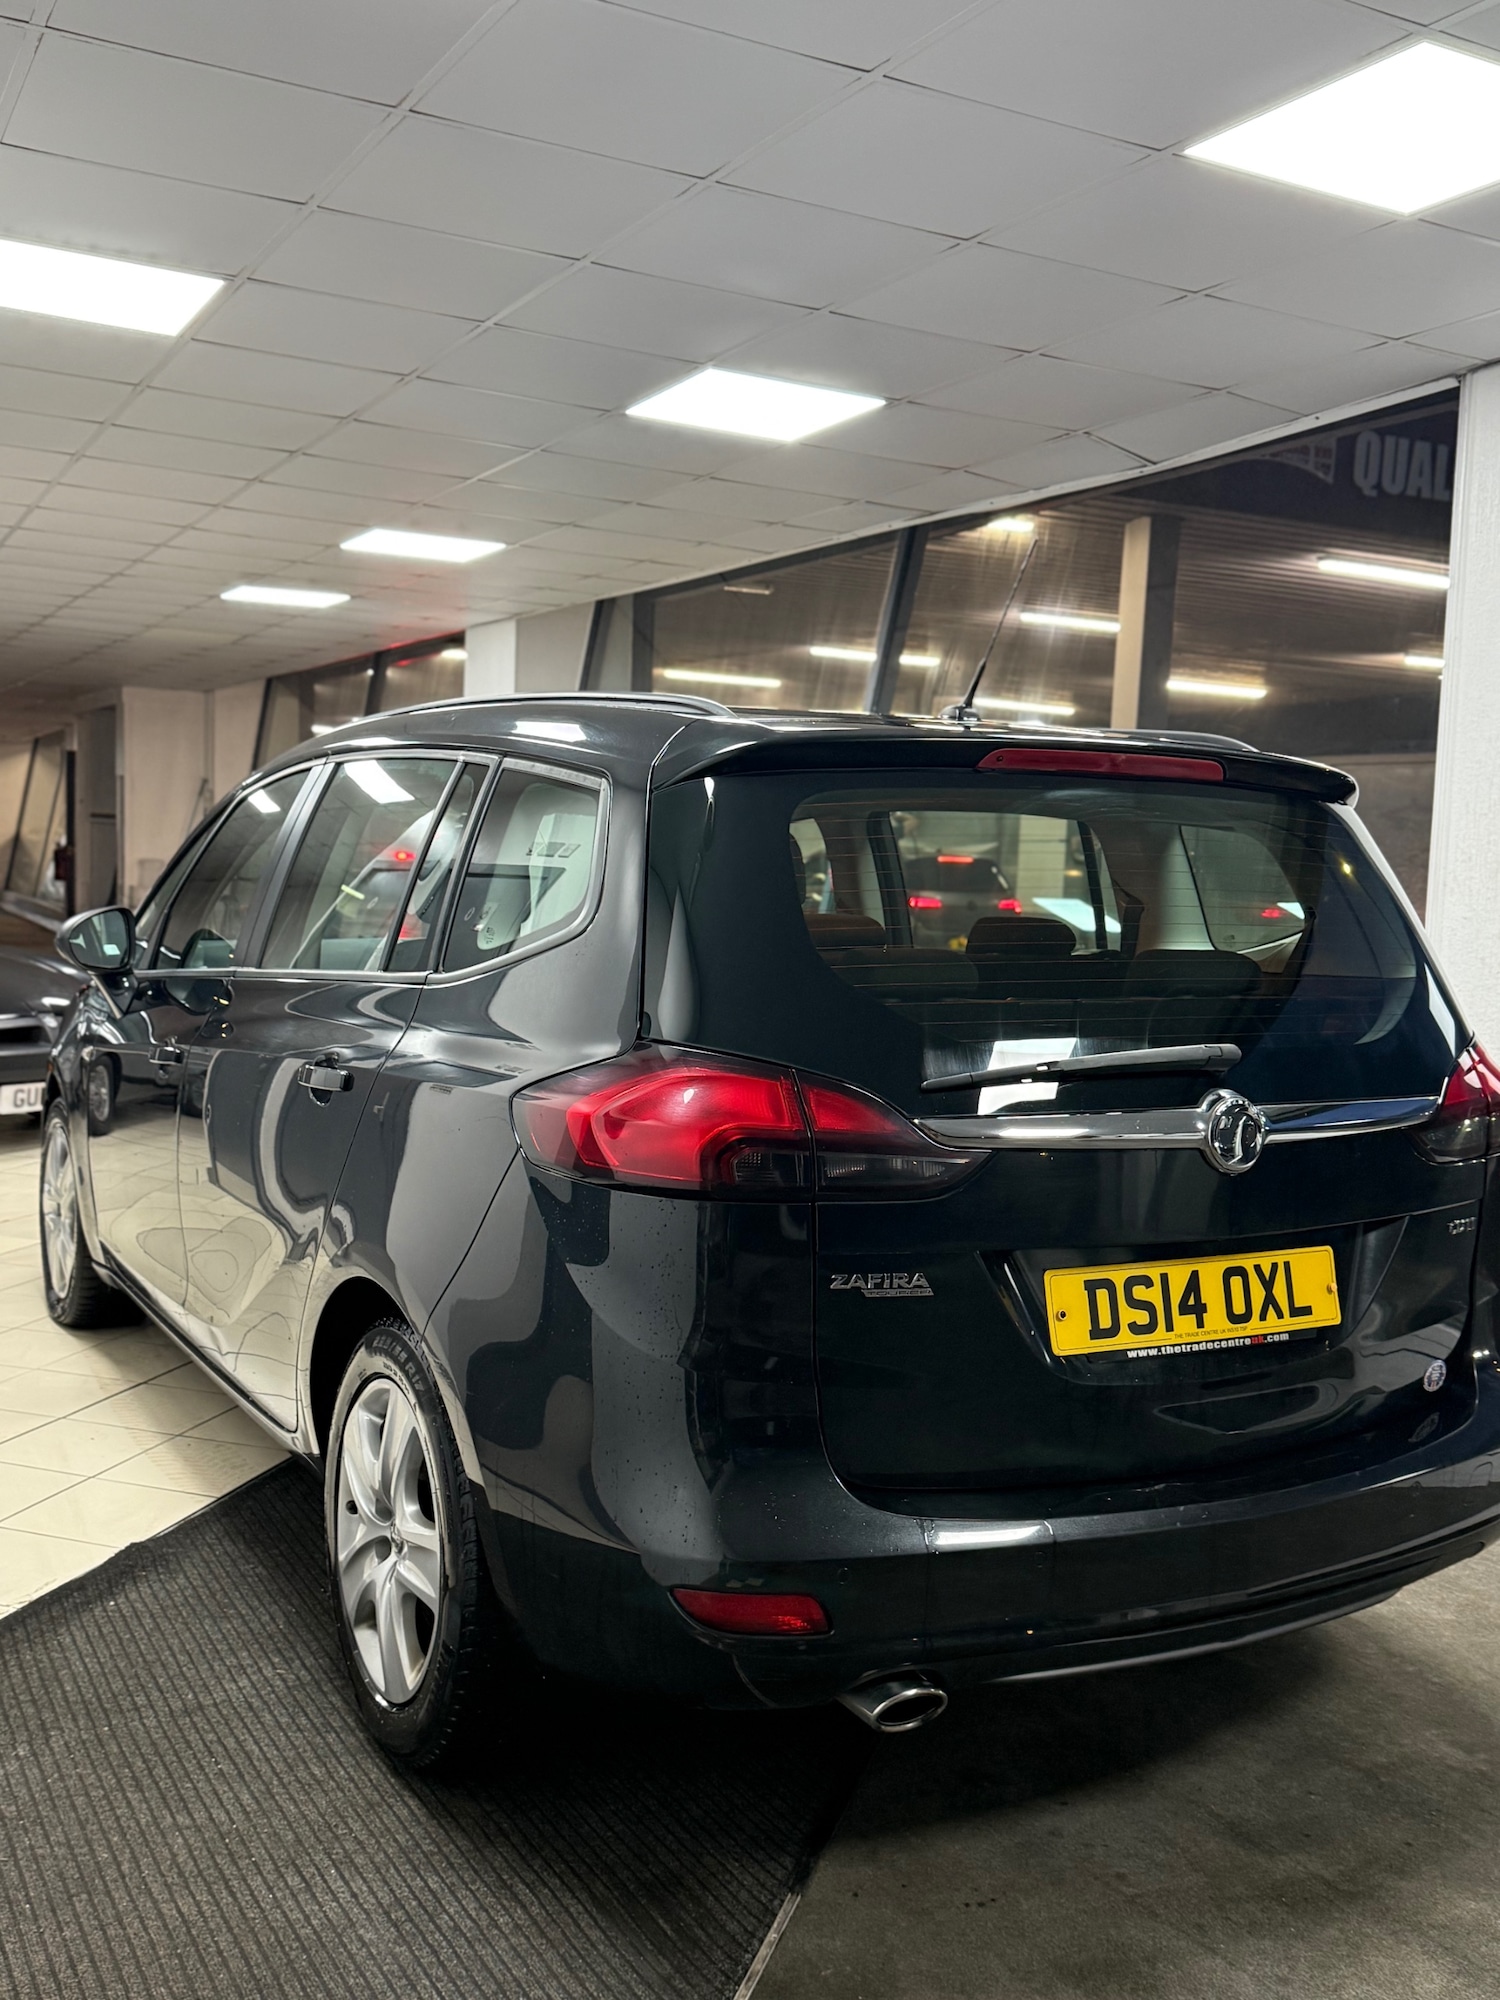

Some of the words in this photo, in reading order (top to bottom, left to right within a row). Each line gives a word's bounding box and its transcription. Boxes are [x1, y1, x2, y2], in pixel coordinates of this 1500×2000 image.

[830, 1272, 930, 1289] ZAFIRA
[1083, 1269, 1208, 1340] DS14
[1221, 1260, 1313, 1325] OXL
[1201, 1329, 1219, 1337] CENTRE
[1127, 1332, 1289, 1358] www.thetradecentreuk.com
